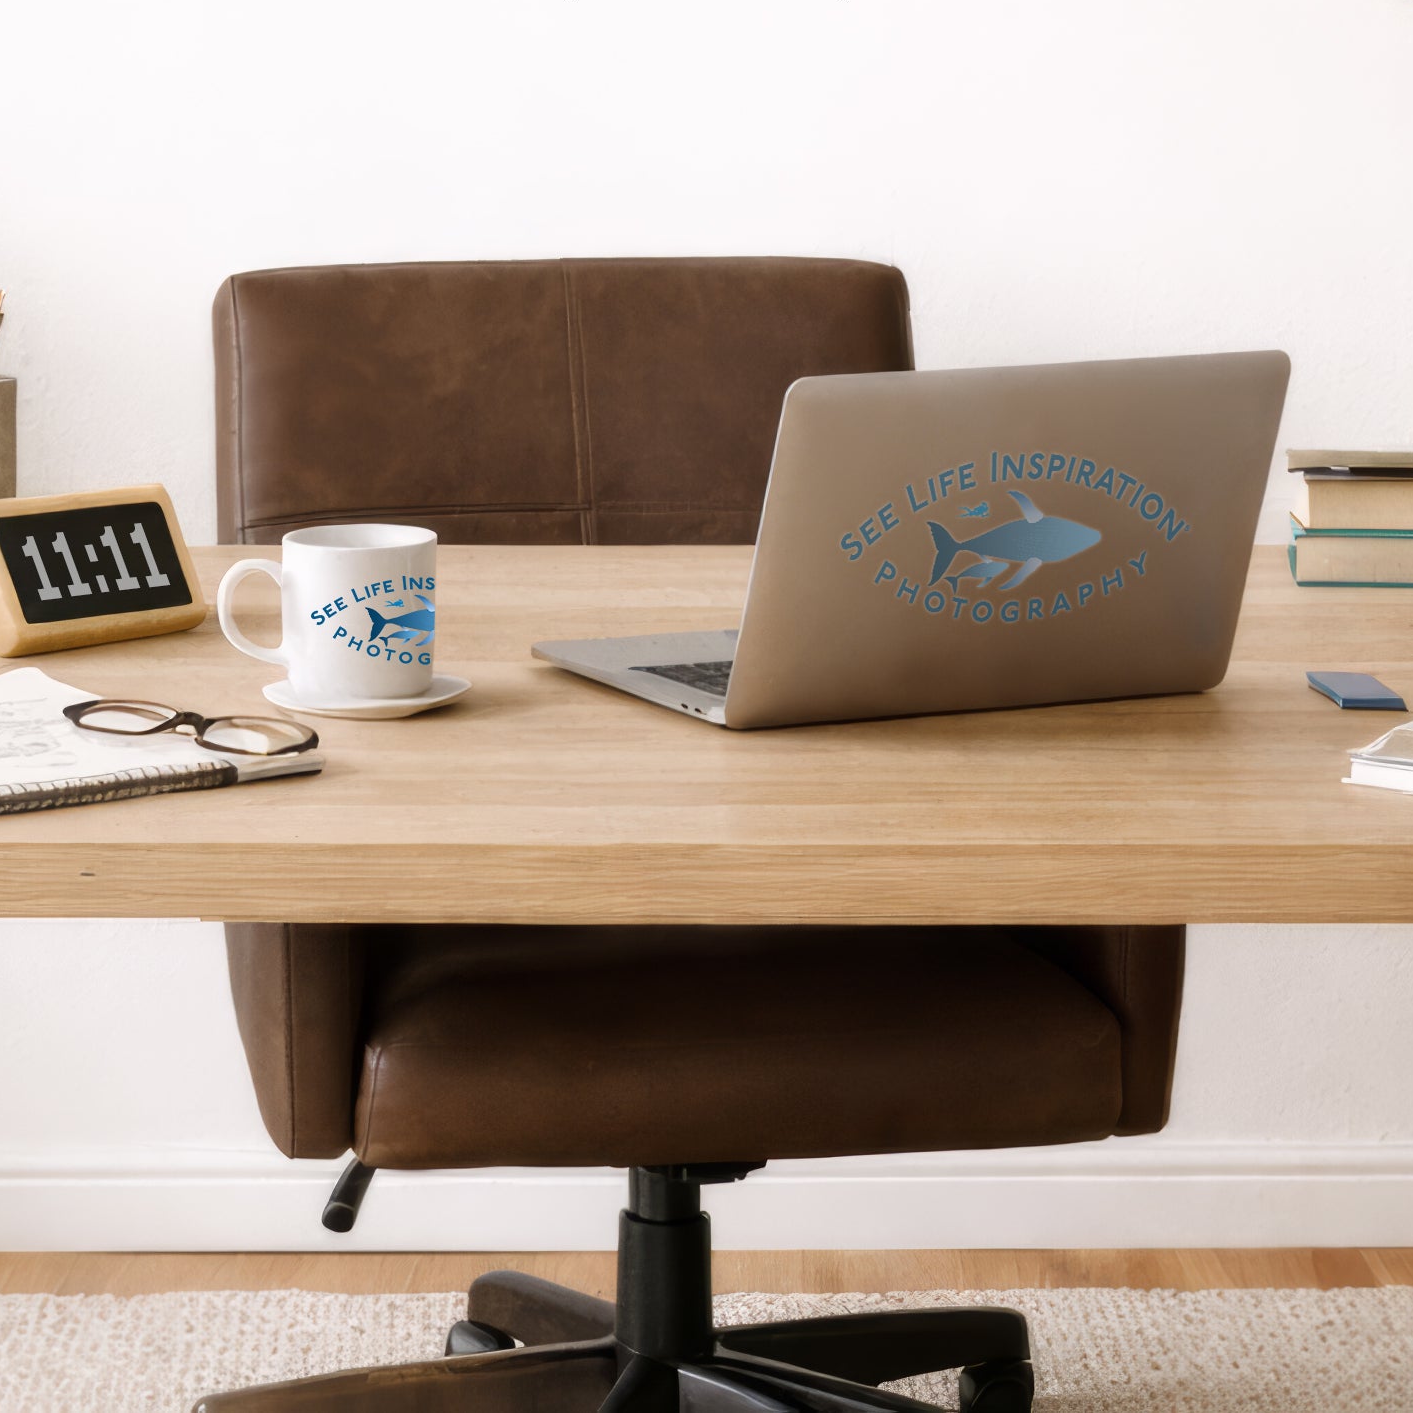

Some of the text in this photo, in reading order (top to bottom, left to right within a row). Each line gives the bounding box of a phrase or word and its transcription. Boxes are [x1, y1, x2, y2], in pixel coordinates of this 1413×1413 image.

[839, 502, 901, 561] SEE
[905, 462, 978, 513] LIFE
[21, 522, 171, 602] 11:11
[873, 550, 1149, 624] PHOTOGRAPHY
[310, 596, 348, 626] SEE
[351, 578, 395, 604] LIFE
[332, 626, 432, 666] PHOTOG
